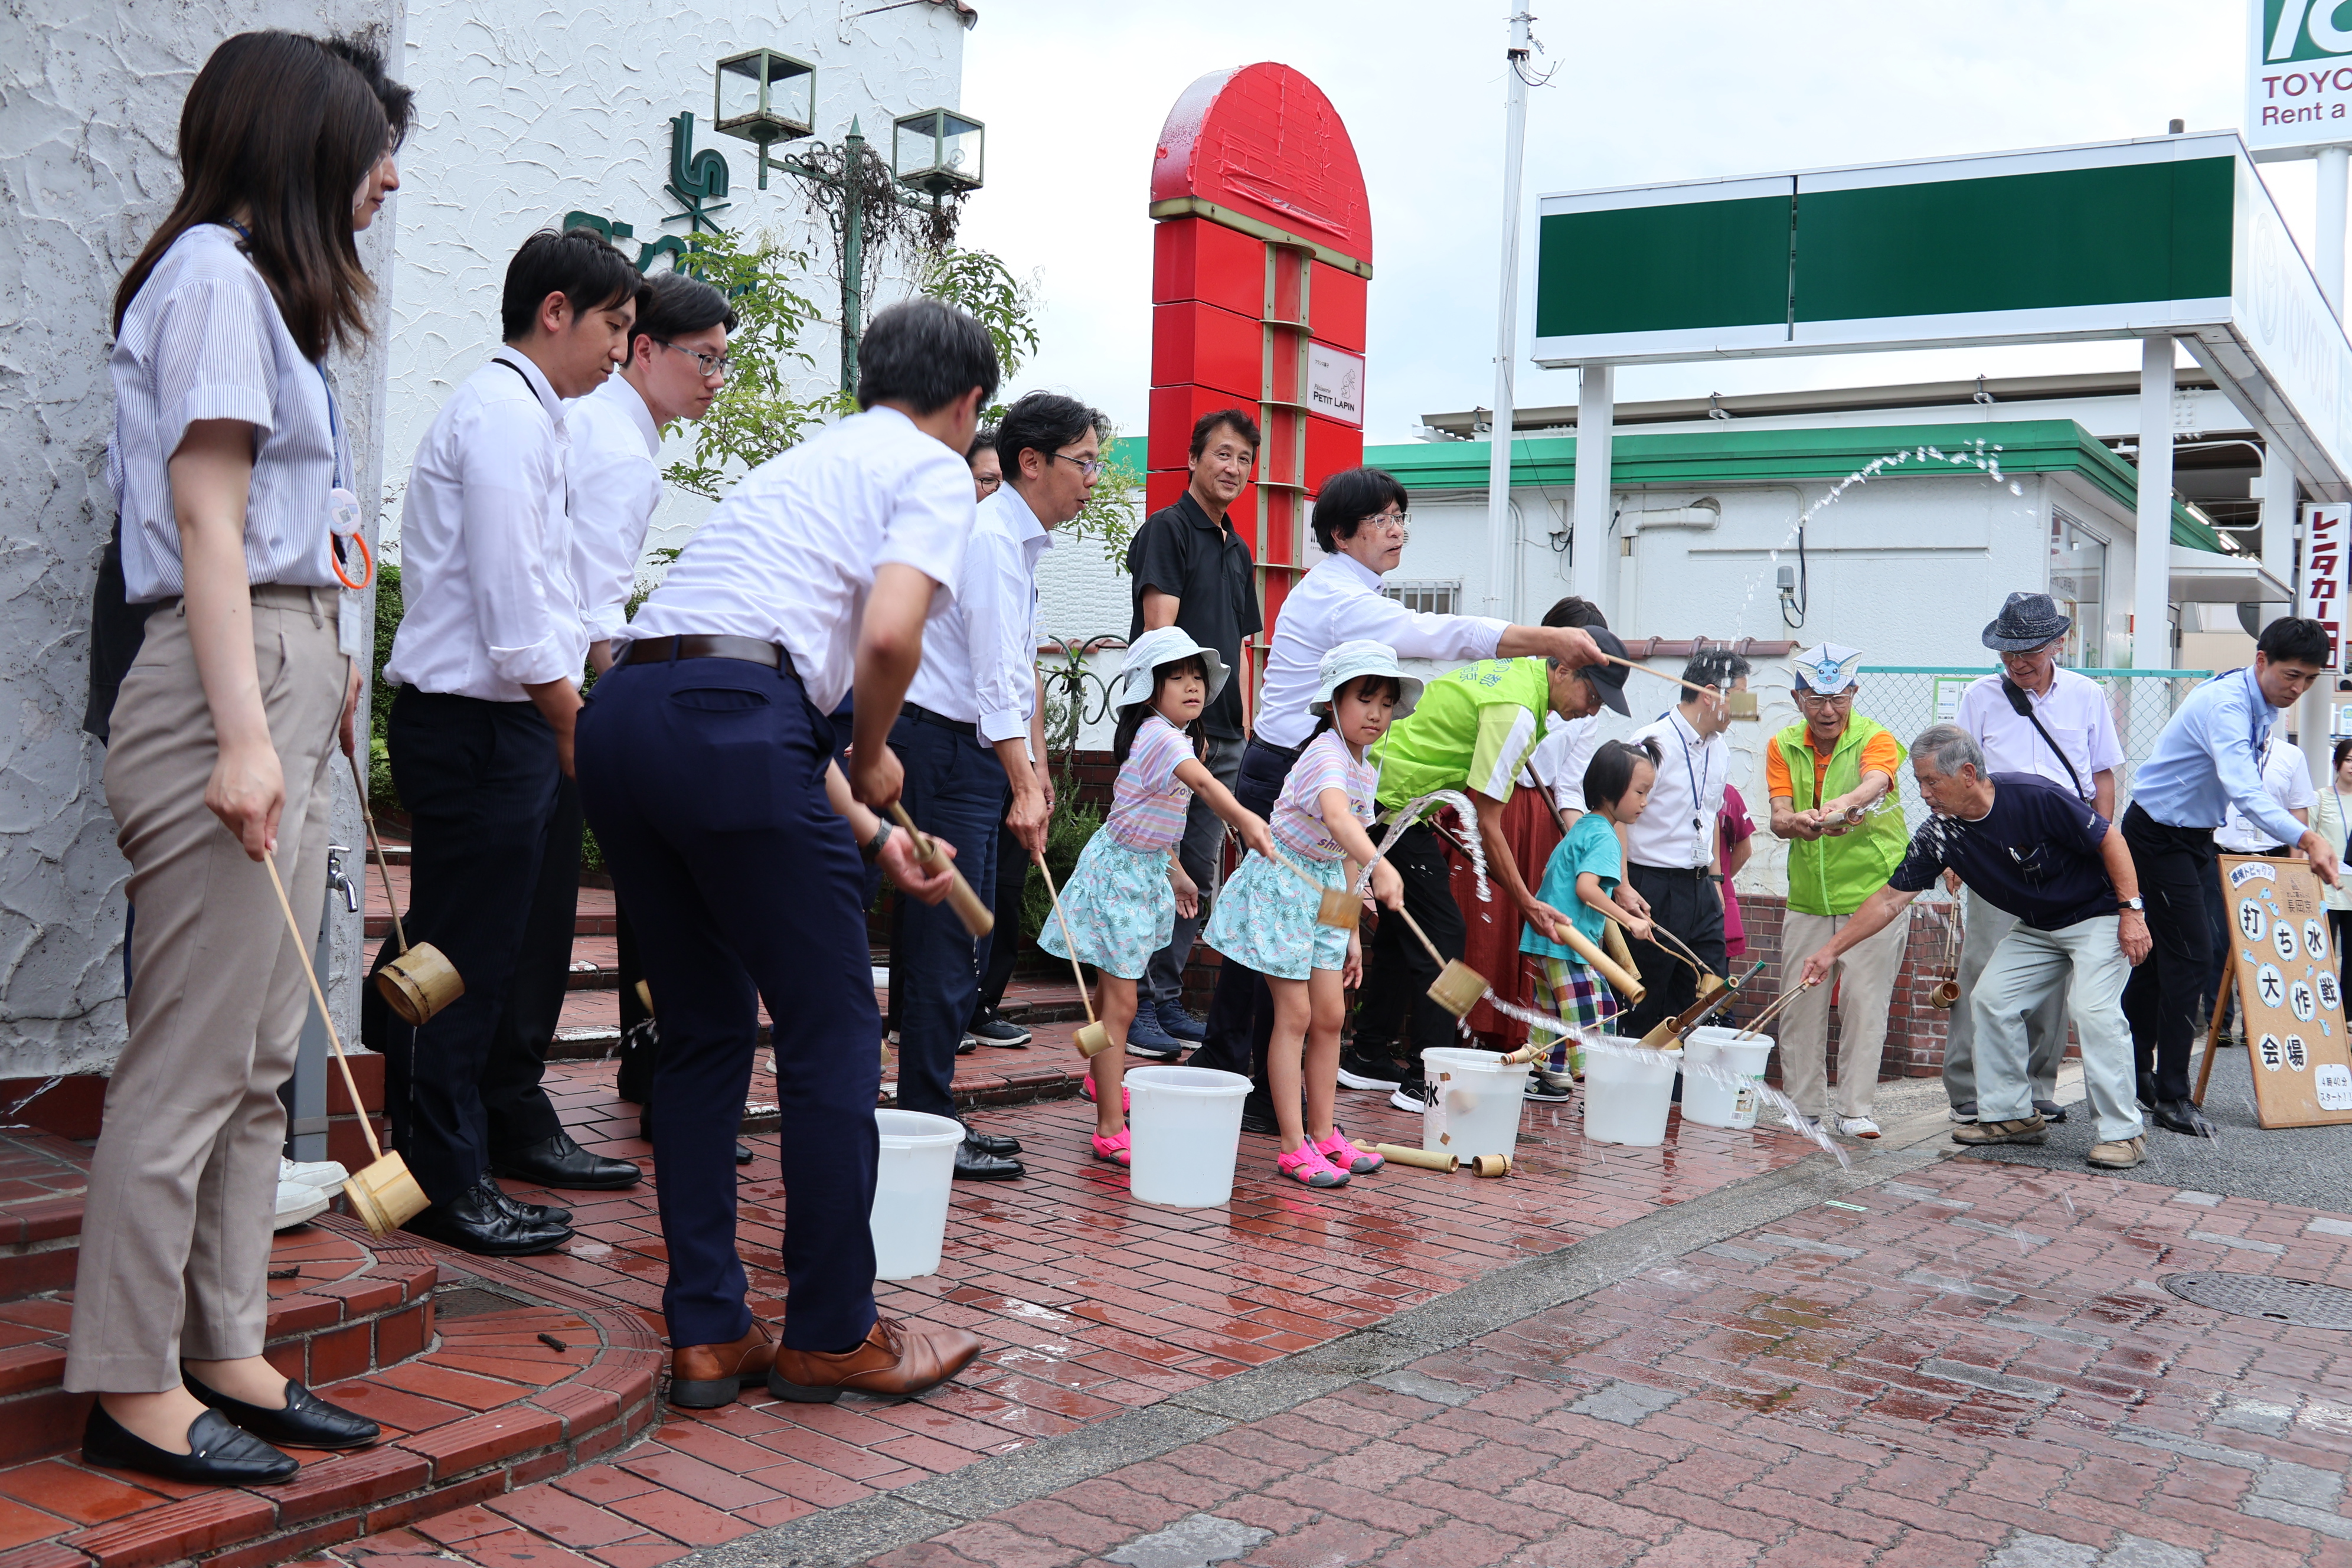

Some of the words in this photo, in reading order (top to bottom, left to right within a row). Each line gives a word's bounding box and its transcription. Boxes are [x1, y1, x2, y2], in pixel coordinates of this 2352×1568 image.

[2262, 102, 2323, 126] Rent
[2331, 103, 2346, 118] a
[1314, 391, 1333, 405] PETIT
[1334, 397, 1354, 412] LAPIN
[2288, 899, 2313, 914] 長岡京
[2262, 971, 2338, 1015] 大作戦
[2262, 1037, 2305, 1067] 会場
